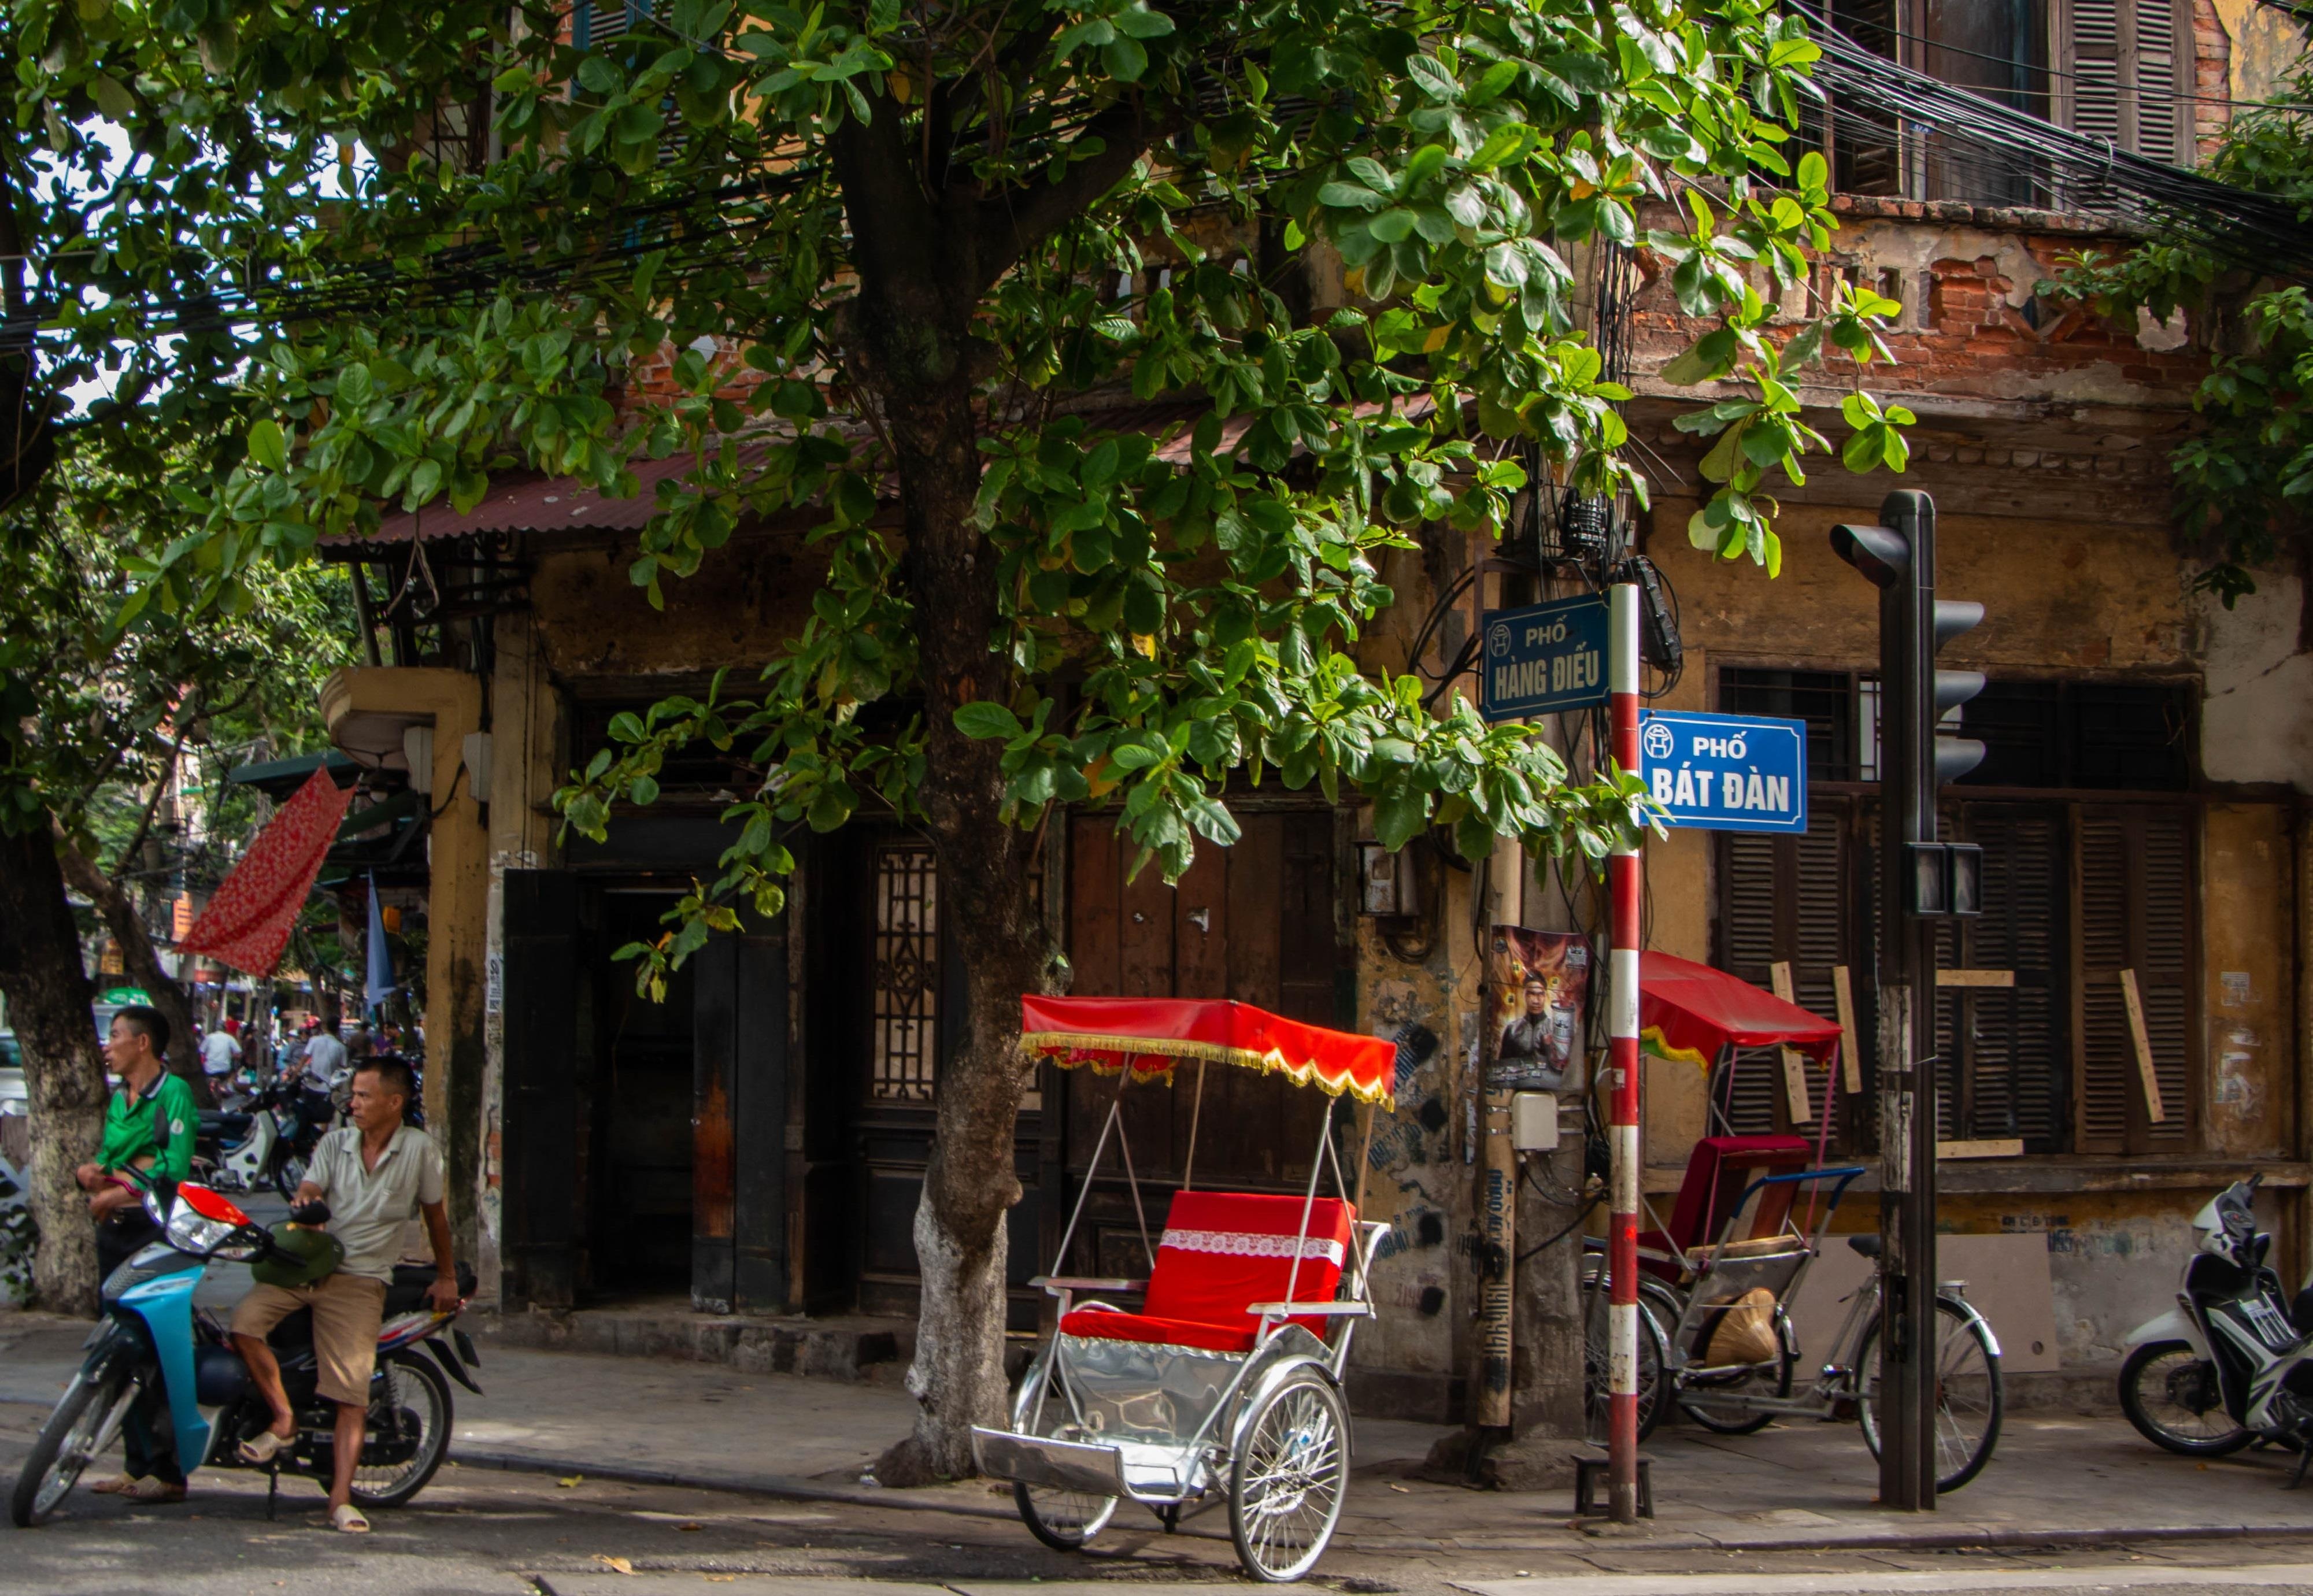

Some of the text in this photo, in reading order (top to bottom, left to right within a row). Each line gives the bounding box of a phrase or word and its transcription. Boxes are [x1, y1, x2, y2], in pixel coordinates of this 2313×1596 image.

[1526, 614, 1568, 647] PHỐ
[1495, 641, 1599, 701] HÀNG ĐIẾU
[1693, 731, 1748, 759] PHỐ
[1652, 761, 1789, 812] BÁT ĐÀN
